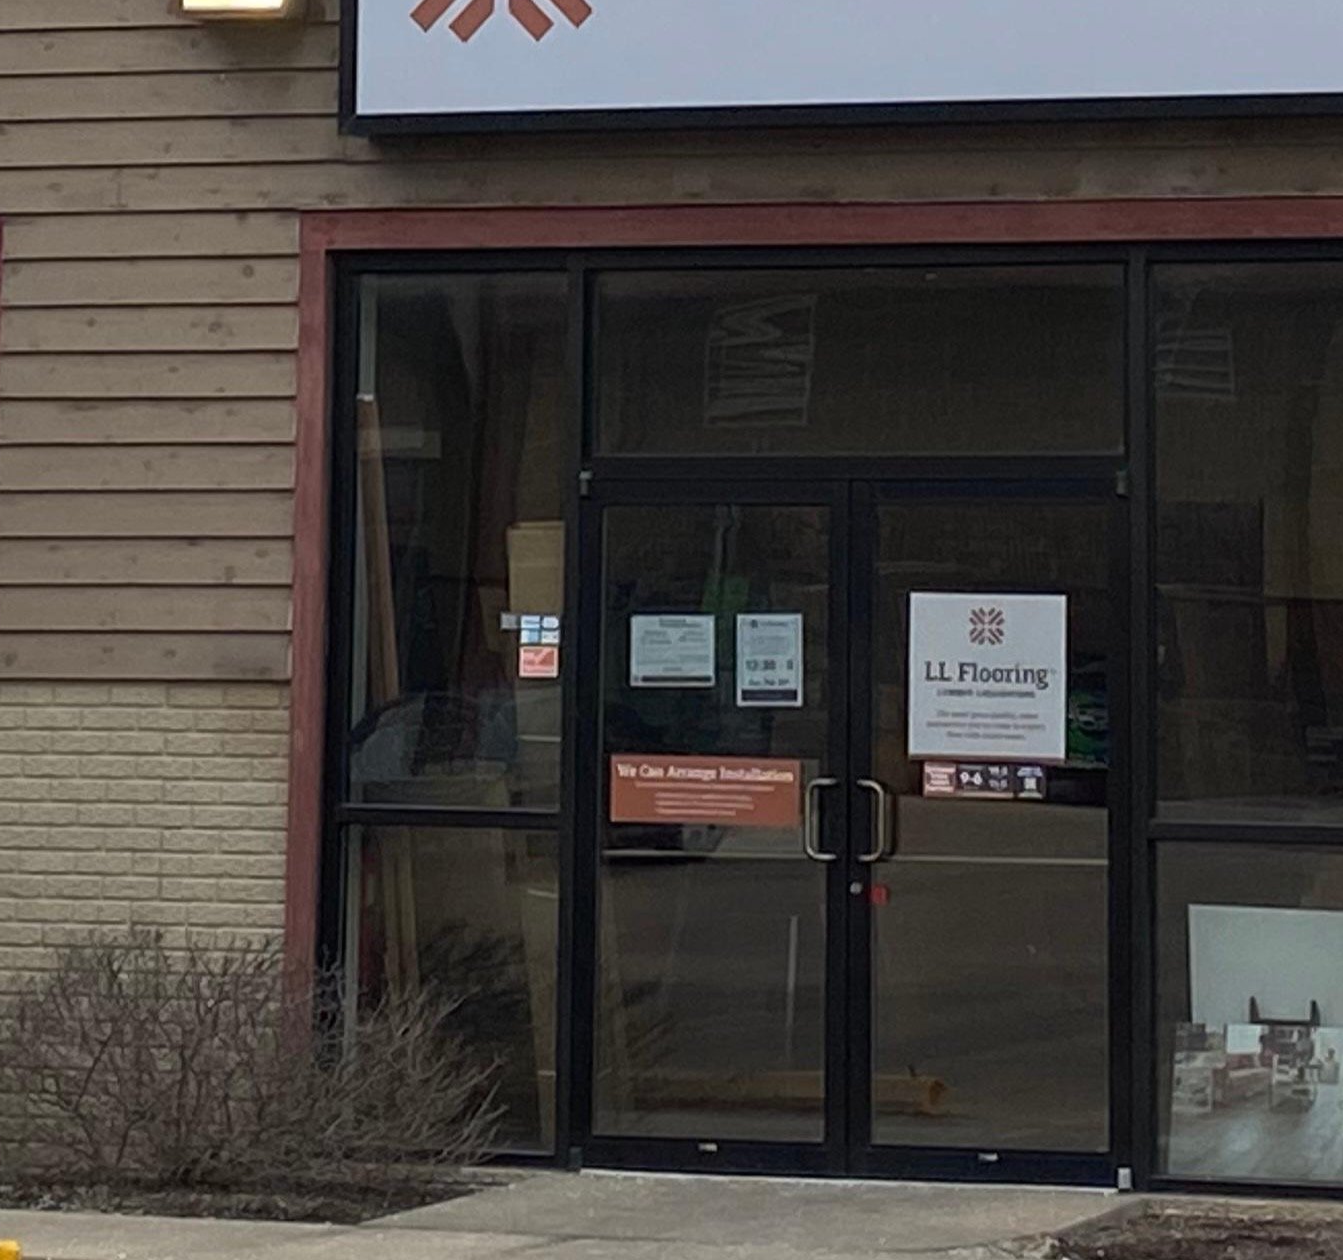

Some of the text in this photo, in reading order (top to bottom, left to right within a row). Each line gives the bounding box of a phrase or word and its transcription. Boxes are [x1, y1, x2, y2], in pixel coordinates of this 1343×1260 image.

[924, 660, 1050, 691] LL Flooring
[616, 763, 795, 783] We Can Arrange Installation
